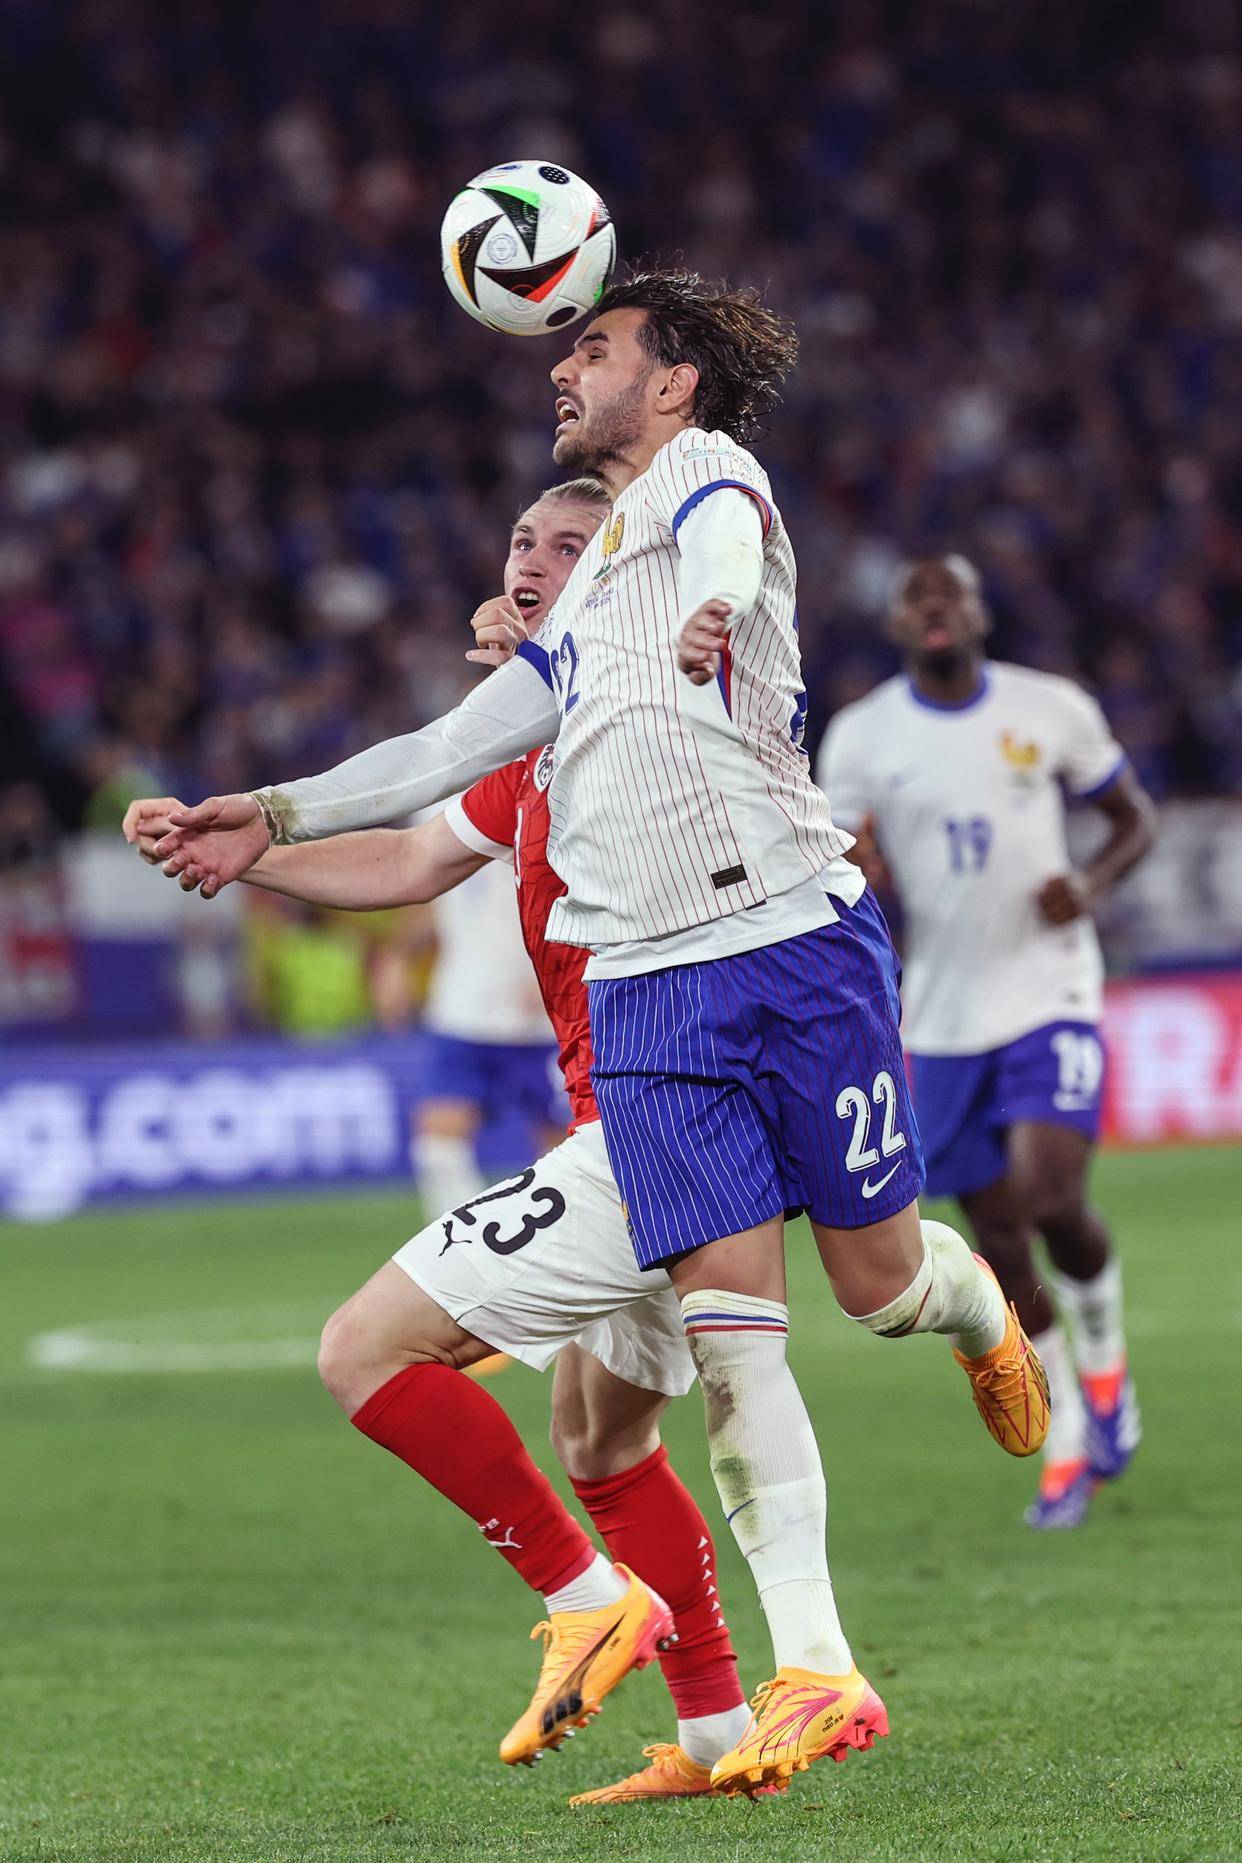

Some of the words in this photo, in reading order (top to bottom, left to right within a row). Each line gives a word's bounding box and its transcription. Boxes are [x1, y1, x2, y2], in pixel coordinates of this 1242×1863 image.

[945, 818, 992, 874] 19
[1051, 1031, 1103, 1097] 19
[836, 1071, 906, 1173] 22
[452, 1168, 566, 1255] 23
